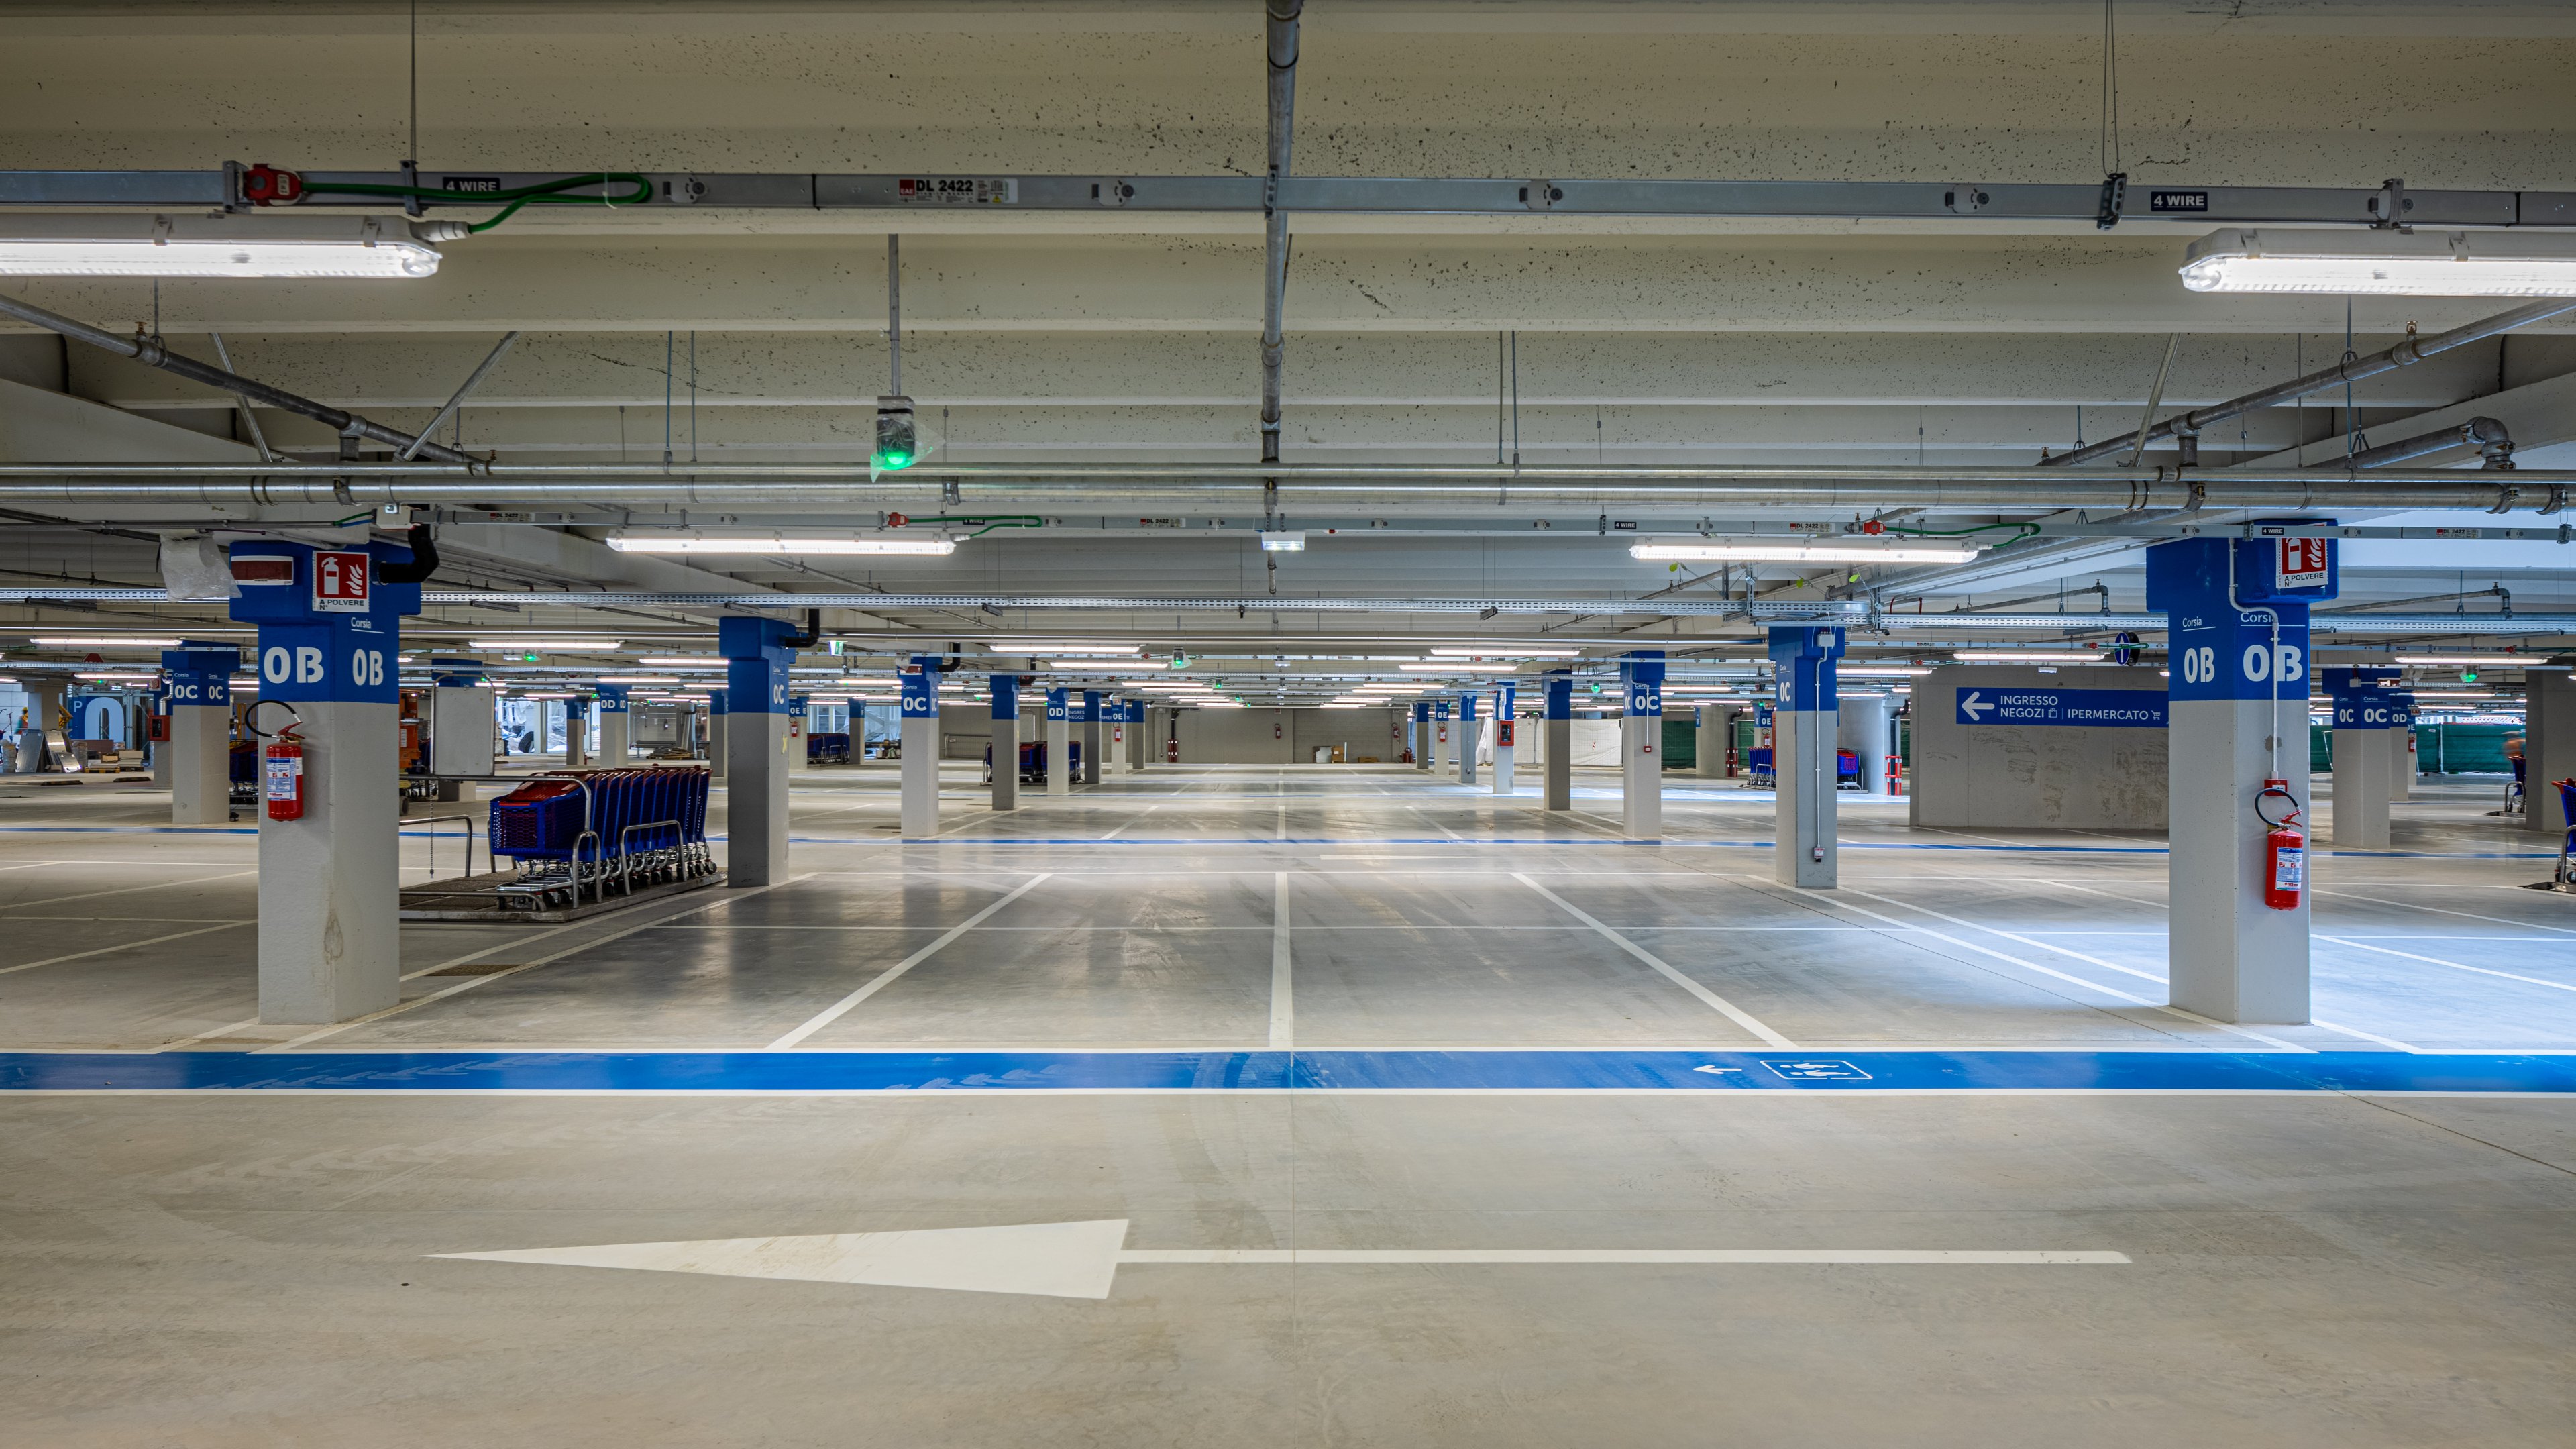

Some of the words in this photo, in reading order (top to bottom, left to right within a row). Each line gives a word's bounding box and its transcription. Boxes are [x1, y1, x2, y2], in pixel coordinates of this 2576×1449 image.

[446, 181, 455, 191] 4
[459, 180, 497, 191] WIRE
[916, 179, 934, 192] DL
[939, 179, 973, 192] 2422
[2153, 195, 2163, 206] 4
[2167, 195, 2205, 207] WIRE
[2291, 572, 2324, 581] POLVERE
[351, 616, 372, 629] Corsia
[2182, 616, 2202, 628] Corsia
[2240, 612, 2275, 623] Corsi
[74, 700, 83, 712] P
[2000, 695, 2059, 706] INGRESSO
[2000, 708, 2045, 718] NEGOZI
[2068, 708, 2149, 720] IPERMERCATO
